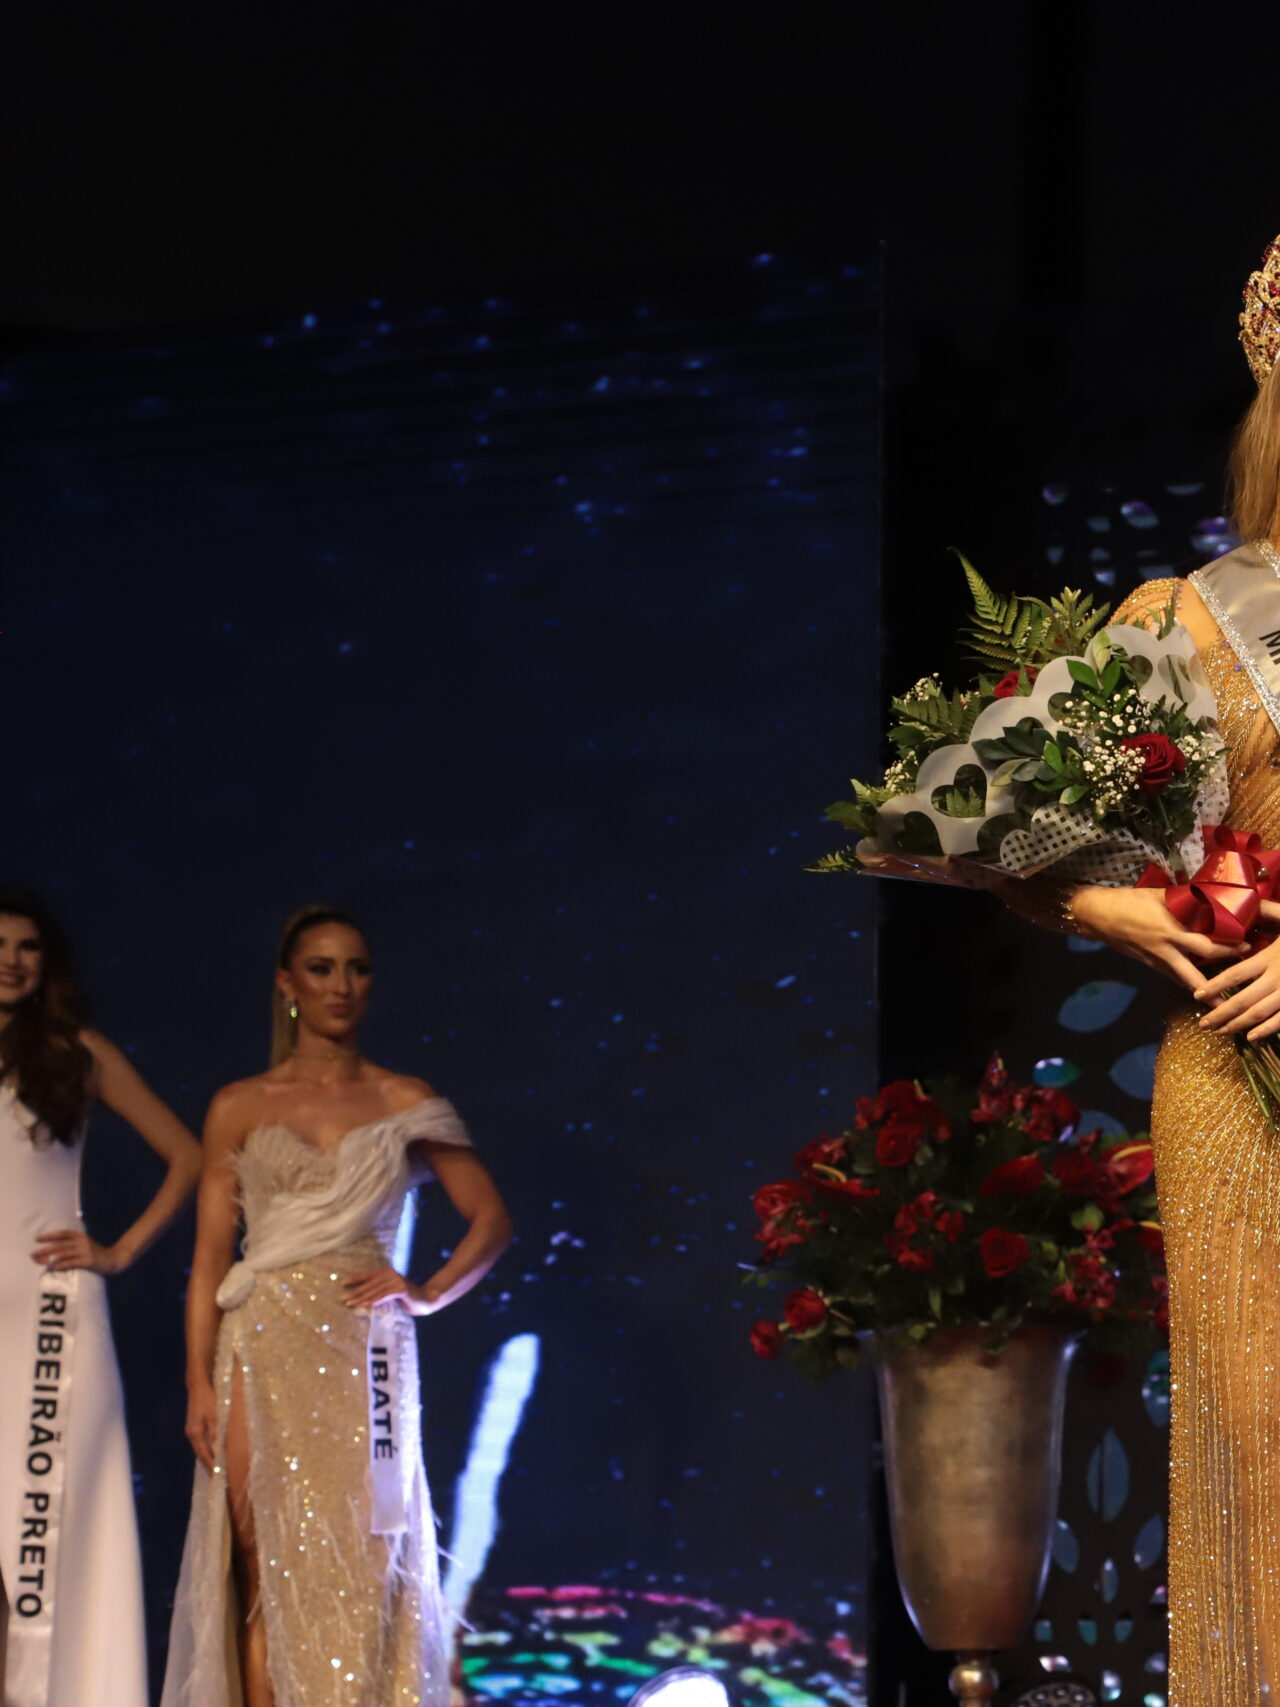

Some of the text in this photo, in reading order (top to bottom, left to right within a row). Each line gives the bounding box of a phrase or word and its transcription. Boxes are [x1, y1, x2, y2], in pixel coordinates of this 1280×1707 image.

[16, 1292, 67, 1619] RIBEIRÃO PRETO
[371, 1346, 398, 1460] IBATÉ
